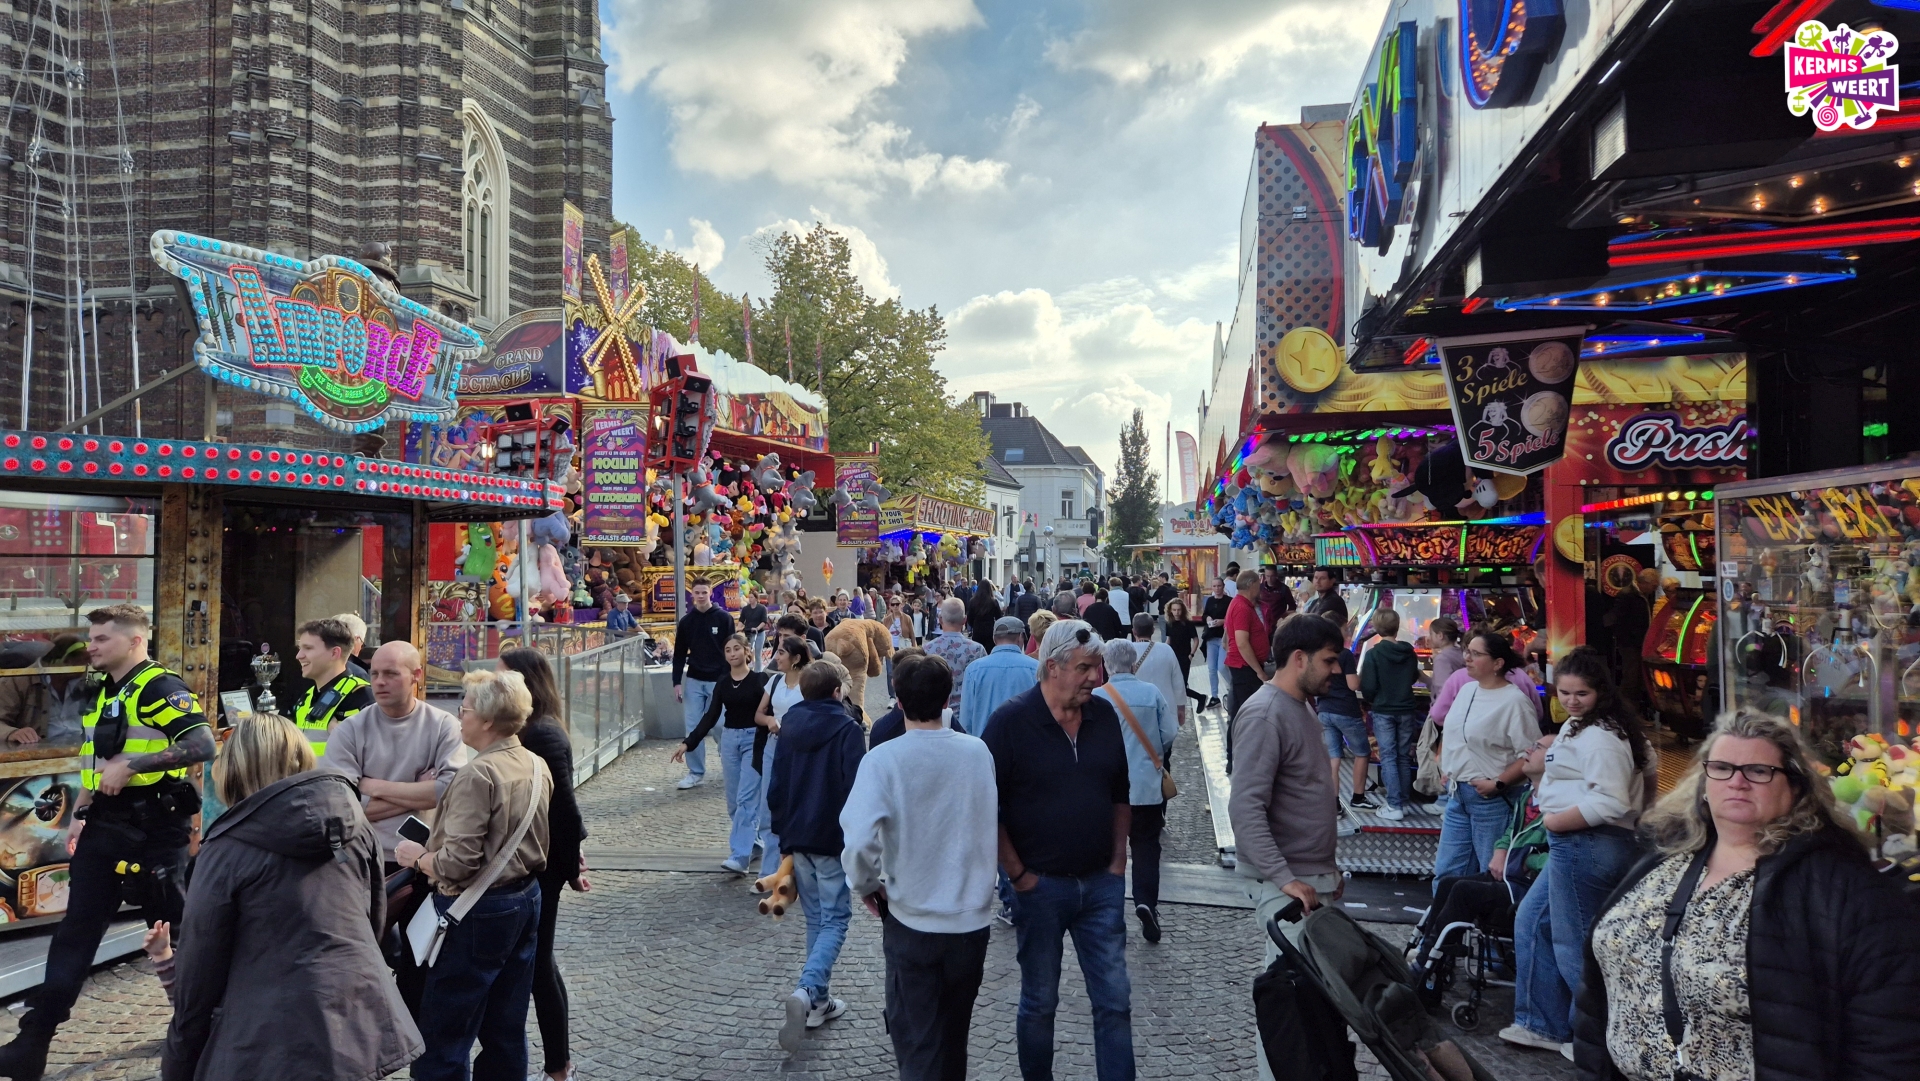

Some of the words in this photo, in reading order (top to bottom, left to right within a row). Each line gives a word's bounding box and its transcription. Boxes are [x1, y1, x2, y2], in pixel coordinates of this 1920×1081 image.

[228, 264, 442, 400] AIRFORCE
[494, 346, 543, 370] GRAND
[1456, 355, 1474, 382] 3
[458, 363, 532, 393] ECTACLE
[1461, 368, 1528, 406] Spiele
[595, 421, 621, 431] KERMIS
[610, 426, 634, 436] WEERT
[1474, 428, 1495, 461] 5
[1495, 428, 1560, 464] Spiele
[592, 457, 639, 470] MOULIN
[594, 471, 637, 485] ROUGE
[854, 472, 869, 480] WEERT
[589, 492, 642, 503] UITZOEKEN
[1374, 536, 1412, 560] FUN
[1417, 537, 1454, 559] CITY
[1467, 534, 1494, 559] FUN
[1498, 536, 1531, 558] CITY
[1604, 556, 1637, 567] CHANGE
